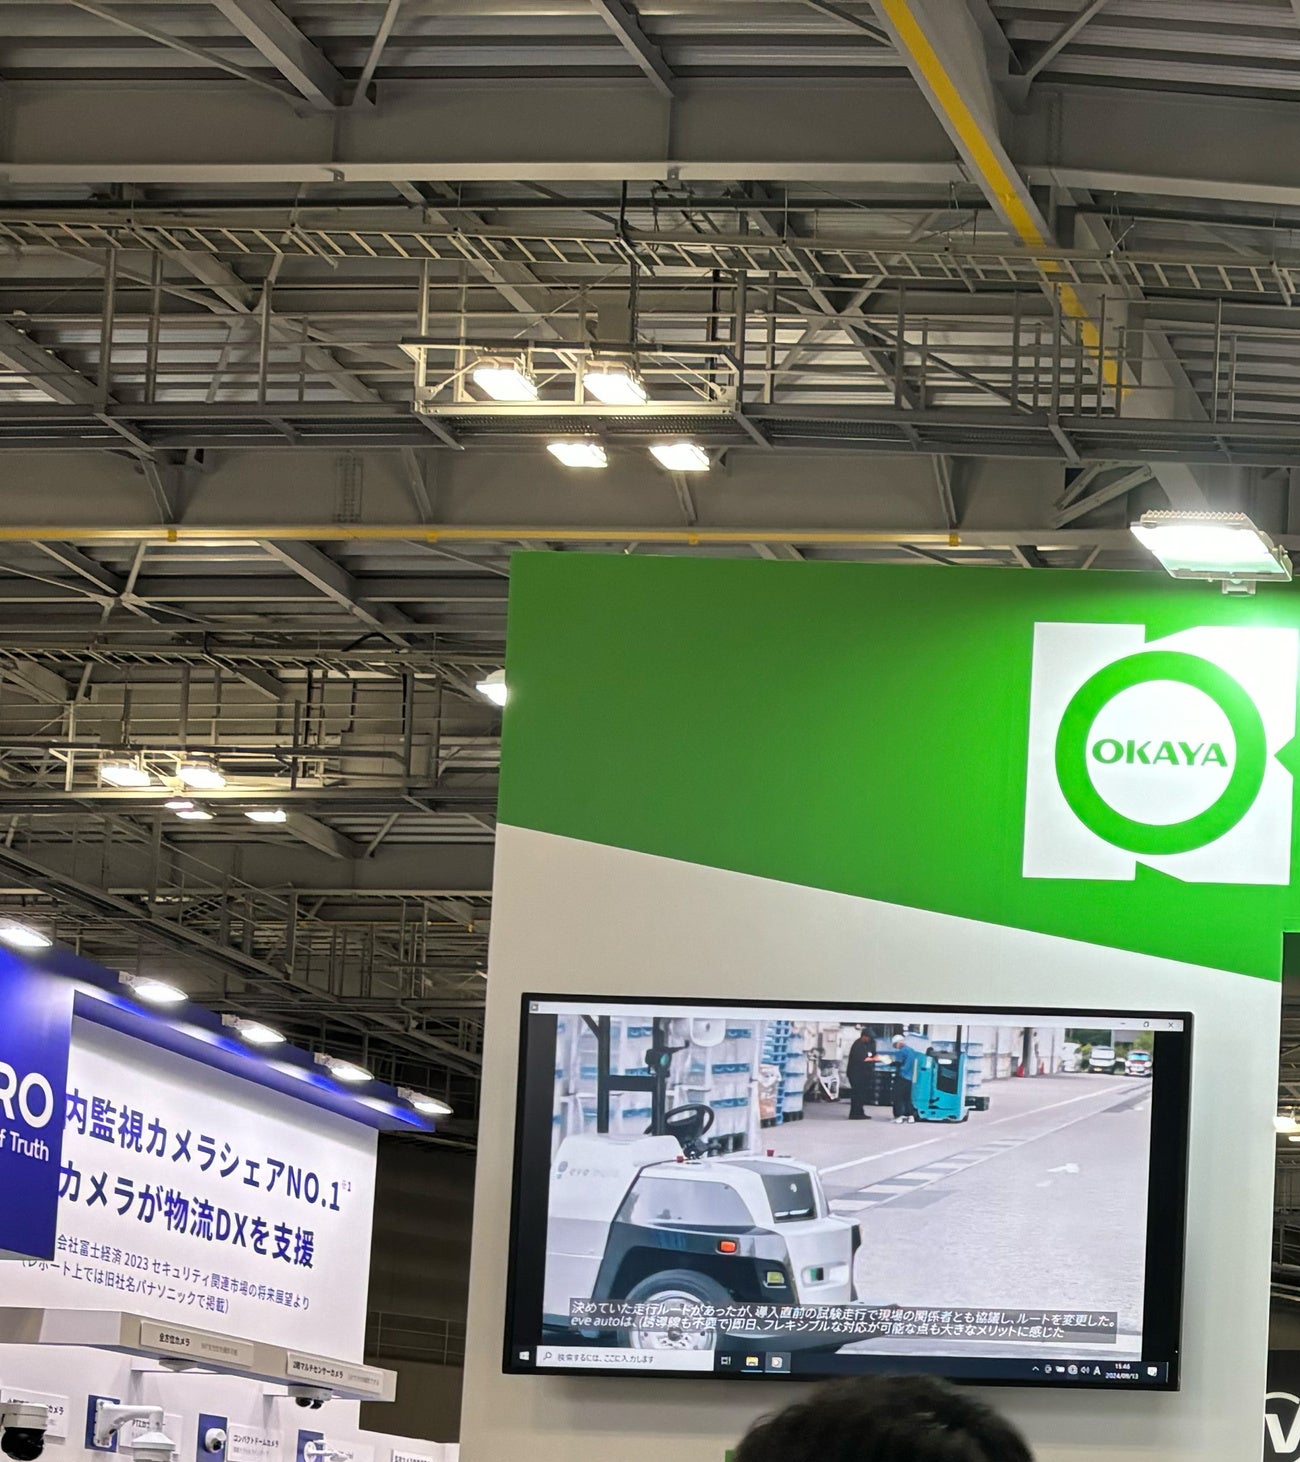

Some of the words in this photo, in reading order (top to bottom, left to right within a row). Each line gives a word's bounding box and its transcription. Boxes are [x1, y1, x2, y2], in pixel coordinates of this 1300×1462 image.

[1092, 737, 1229, 768] OKAYA
[10, 1131, 49, 1161] Truth
[125, 1252, 149, 1271] 2023
